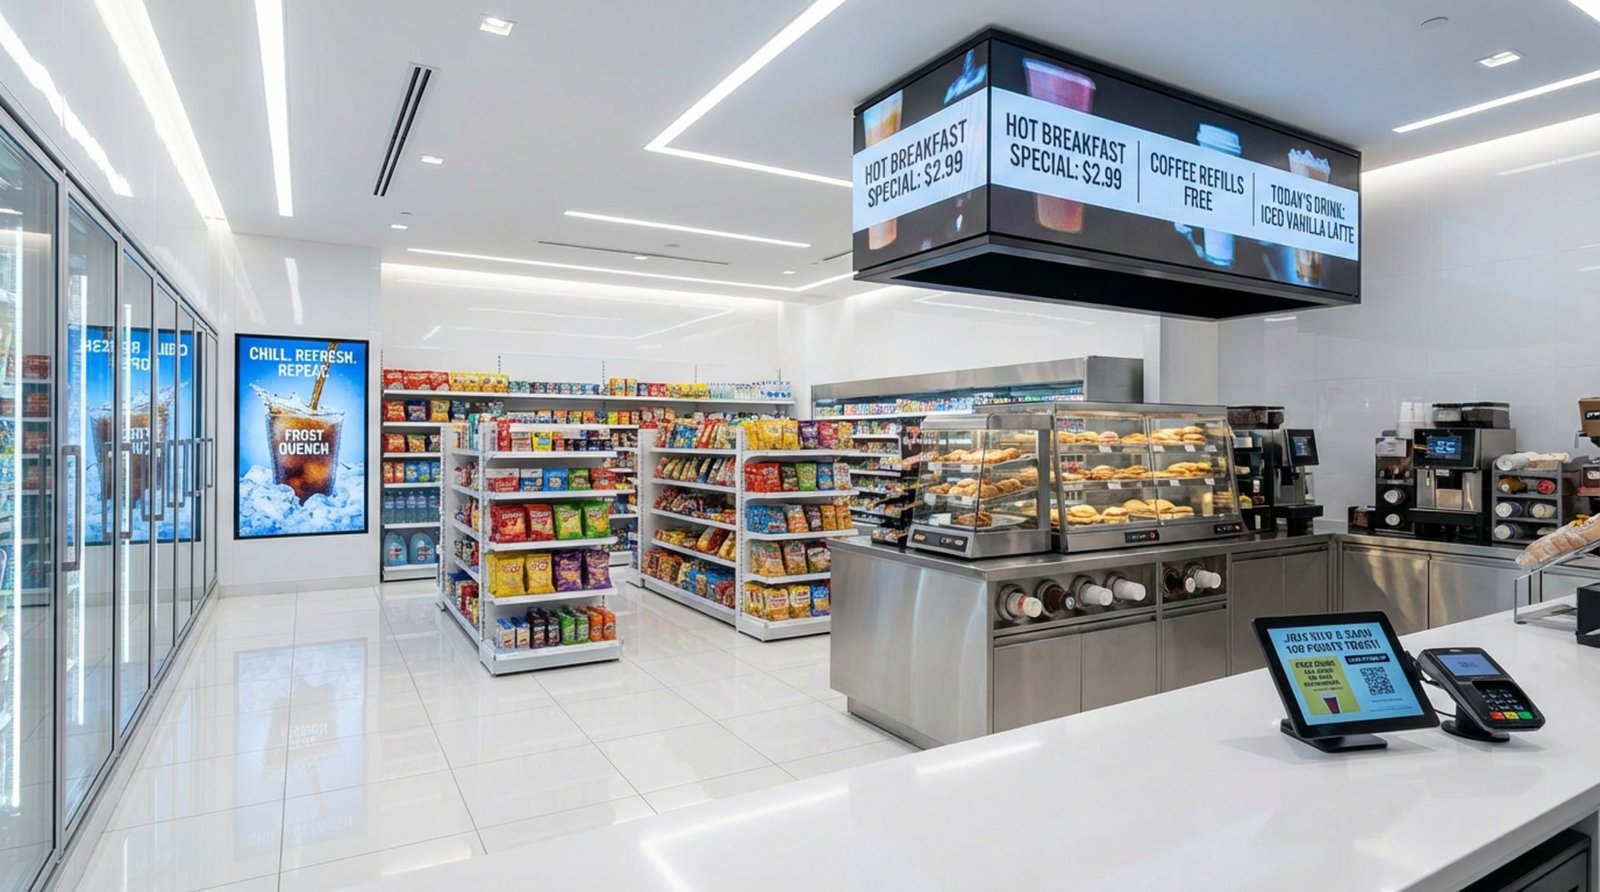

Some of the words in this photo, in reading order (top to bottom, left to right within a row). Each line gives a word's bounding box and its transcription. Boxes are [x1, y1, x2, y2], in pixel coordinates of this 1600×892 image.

[865, 156, 888, 185] HOT
[891, 118, 968, 174] BREAKFAST
[1006, 111, 1038, 142] HOT
[1042, 121, 1127, 165] BREAKFAST
[868, 169, 921, 208] SPECIAL:
[924, 149, 964, 188] $2.99
[1009, 142, 1079, 181] SPECIAL:
[1082, 160, 1122, 190] $2.99
[1150, 151, 1197, 184] COFFEE
[1199, 164, 1244, 195] REFILLS
[1184, 185, 1213, 212] FREE
[1270, 183, 1313, 213] TODAY'S
[1314, 195, 1345, 220] DRINK:
[1261, 204, 1285, 227] ICED
[1286, 210, 1326, 237] VANILLA
[1327, 221, 1355, 244] LATTE
[249, 346, 293, 361] CHILL.
[295, 348, 357, 364] REFRESH.
[285, 428, 325, 441] FROST
